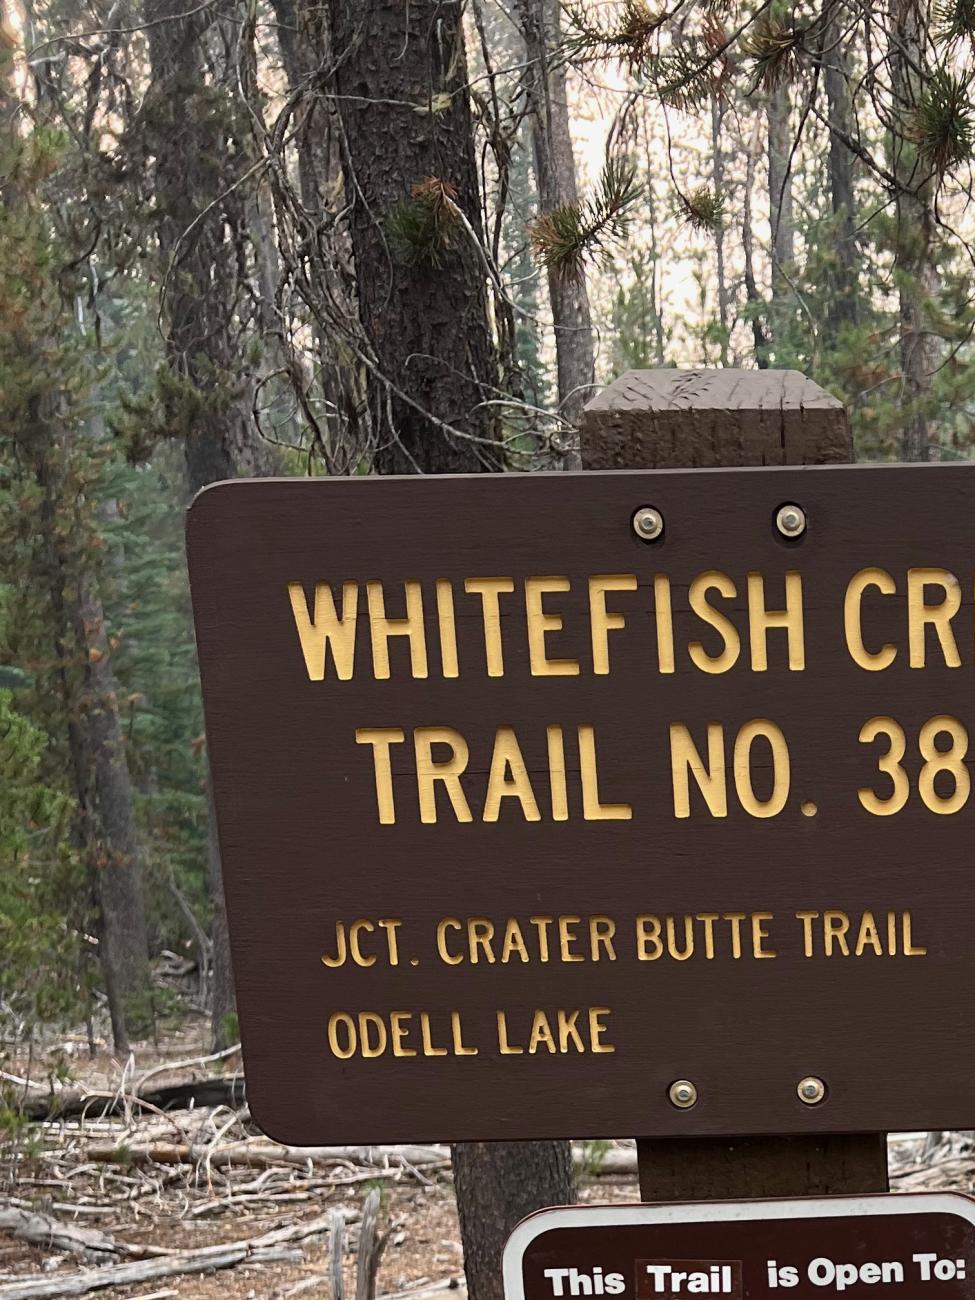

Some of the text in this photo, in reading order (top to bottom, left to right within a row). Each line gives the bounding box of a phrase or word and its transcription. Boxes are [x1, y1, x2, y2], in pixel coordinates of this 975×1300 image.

[288, 575, 806, 681] WHITEFISH
[355, 727, 633, 825] TRAIL
[669, 721, 817, 819] NO.
[321, 920, 418, 968] JCT.
[436, 918, 617, 965] CRATER
[636, 914, 776, 961] BUTTE
[798, 913, 927, 958] TRAIL
[327, 1013, 479, 1059] ODELL
[497, 1009, 615, 1055] LAKE
[543, 1253, 966, 1297] This Trail is Open To:
